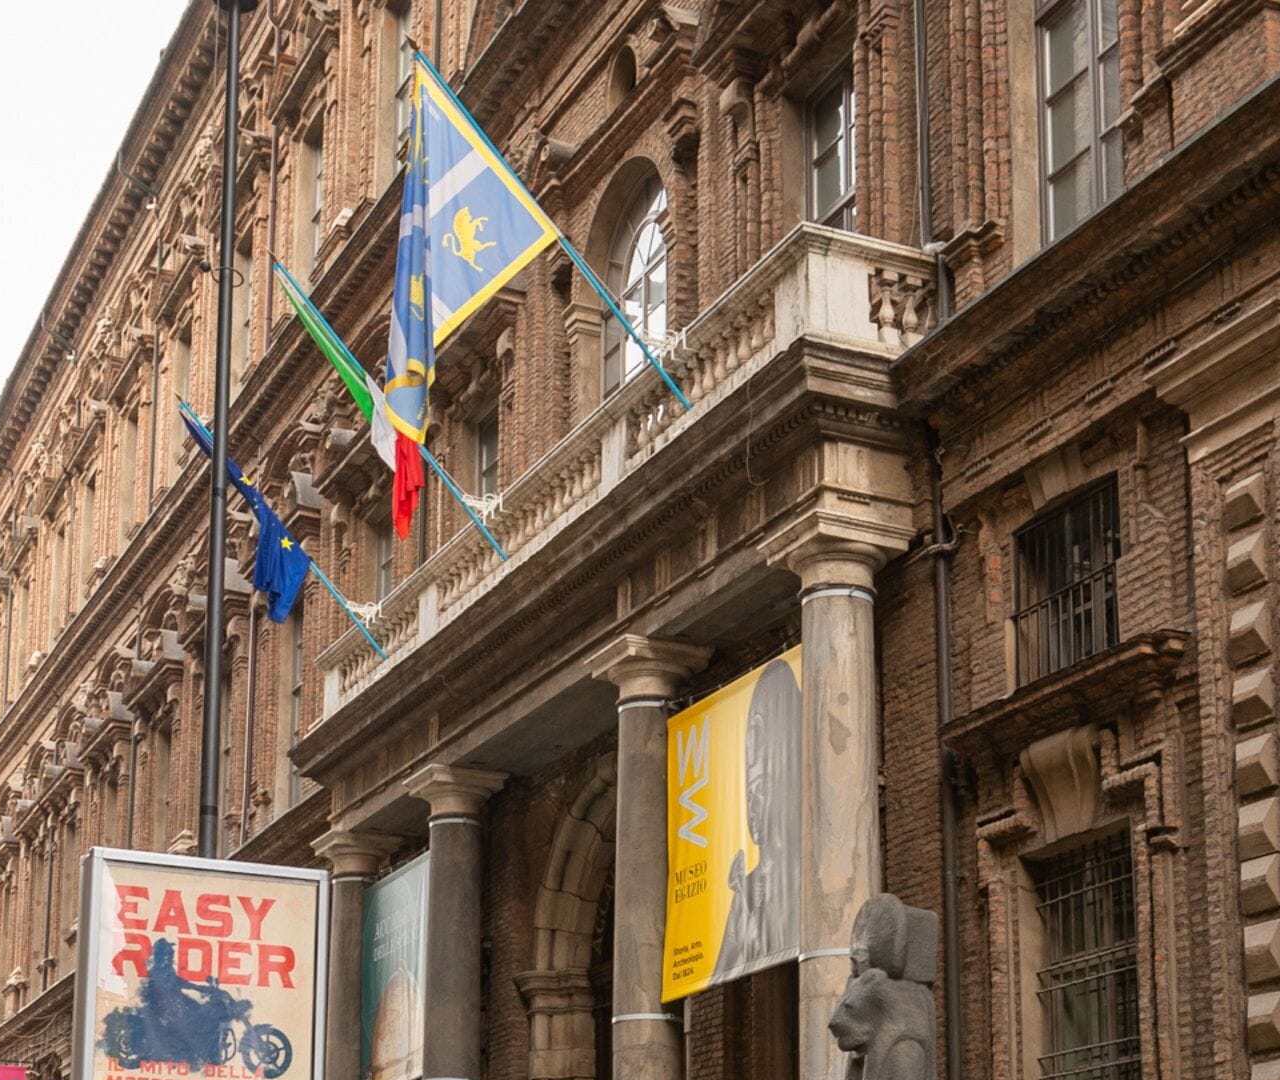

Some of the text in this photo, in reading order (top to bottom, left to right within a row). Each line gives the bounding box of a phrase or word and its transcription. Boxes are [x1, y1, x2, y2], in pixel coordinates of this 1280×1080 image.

[675, 860, 708, 885] MUSEO
[674, 878, 708, 904] EGIZIO
[114, 884, 276, 941] EASY
[111, 932, 296, 989] RDER
[107, 1056, 266, 1080] IL MITO DELLA
